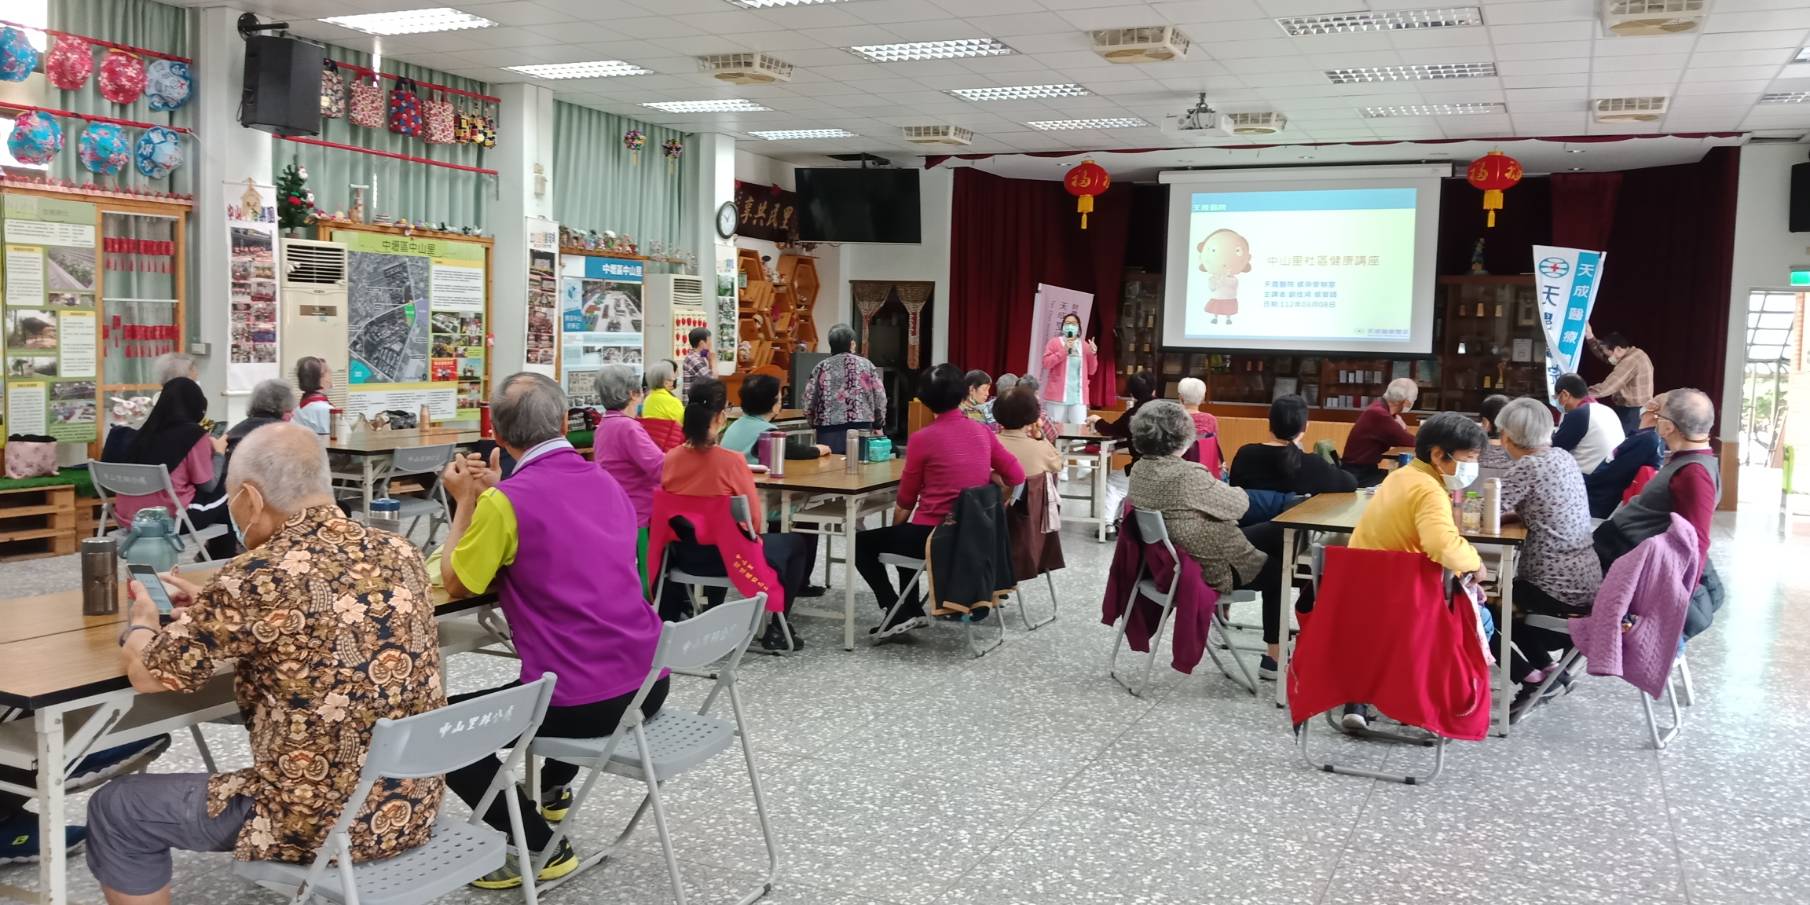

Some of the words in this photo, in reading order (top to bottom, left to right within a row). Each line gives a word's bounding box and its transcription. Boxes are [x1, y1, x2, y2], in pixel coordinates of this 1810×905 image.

[1266, 255, 1380, 267] 中山里社區健康講座
